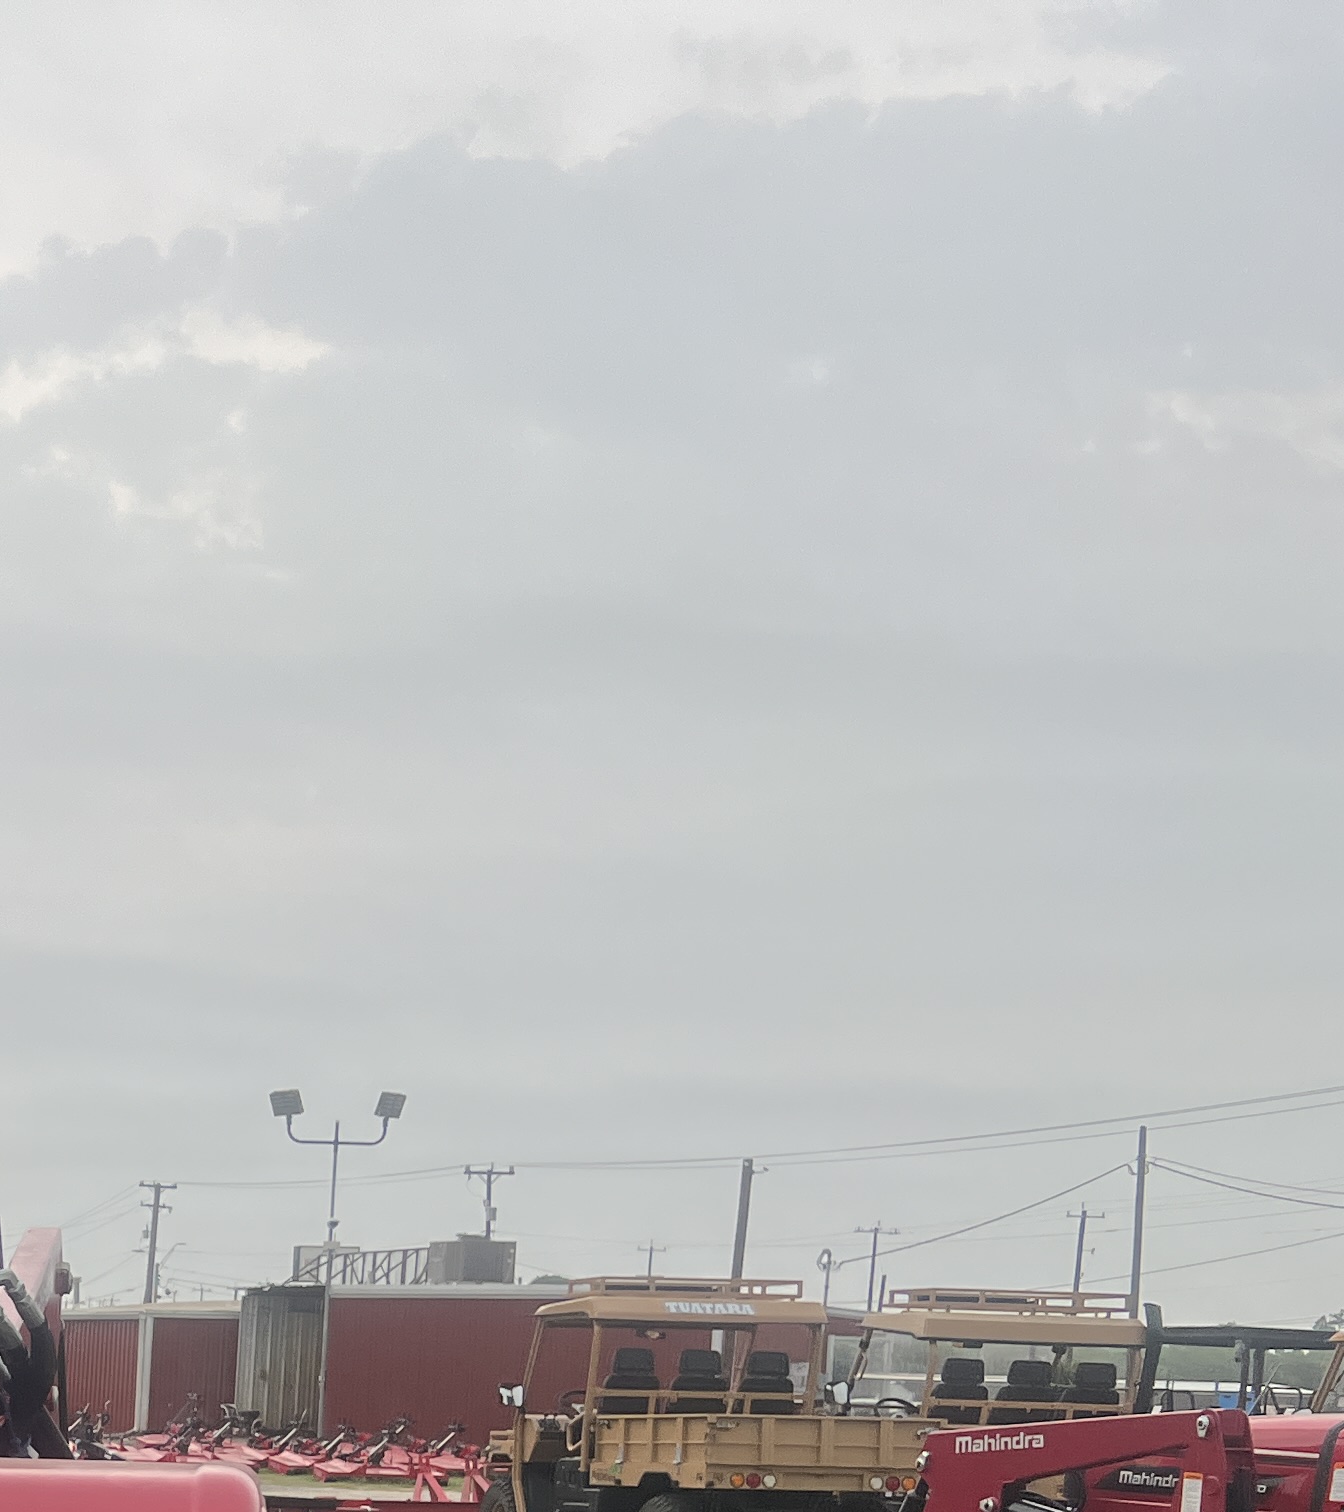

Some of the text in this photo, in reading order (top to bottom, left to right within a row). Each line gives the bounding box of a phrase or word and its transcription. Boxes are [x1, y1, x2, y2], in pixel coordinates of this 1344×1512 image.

[665, 1301, 755, 1316] TUATARA
[955, 1431, 1044, 1454] Mahindra
[1118, 1470, 1180, 1489] Mahindr
